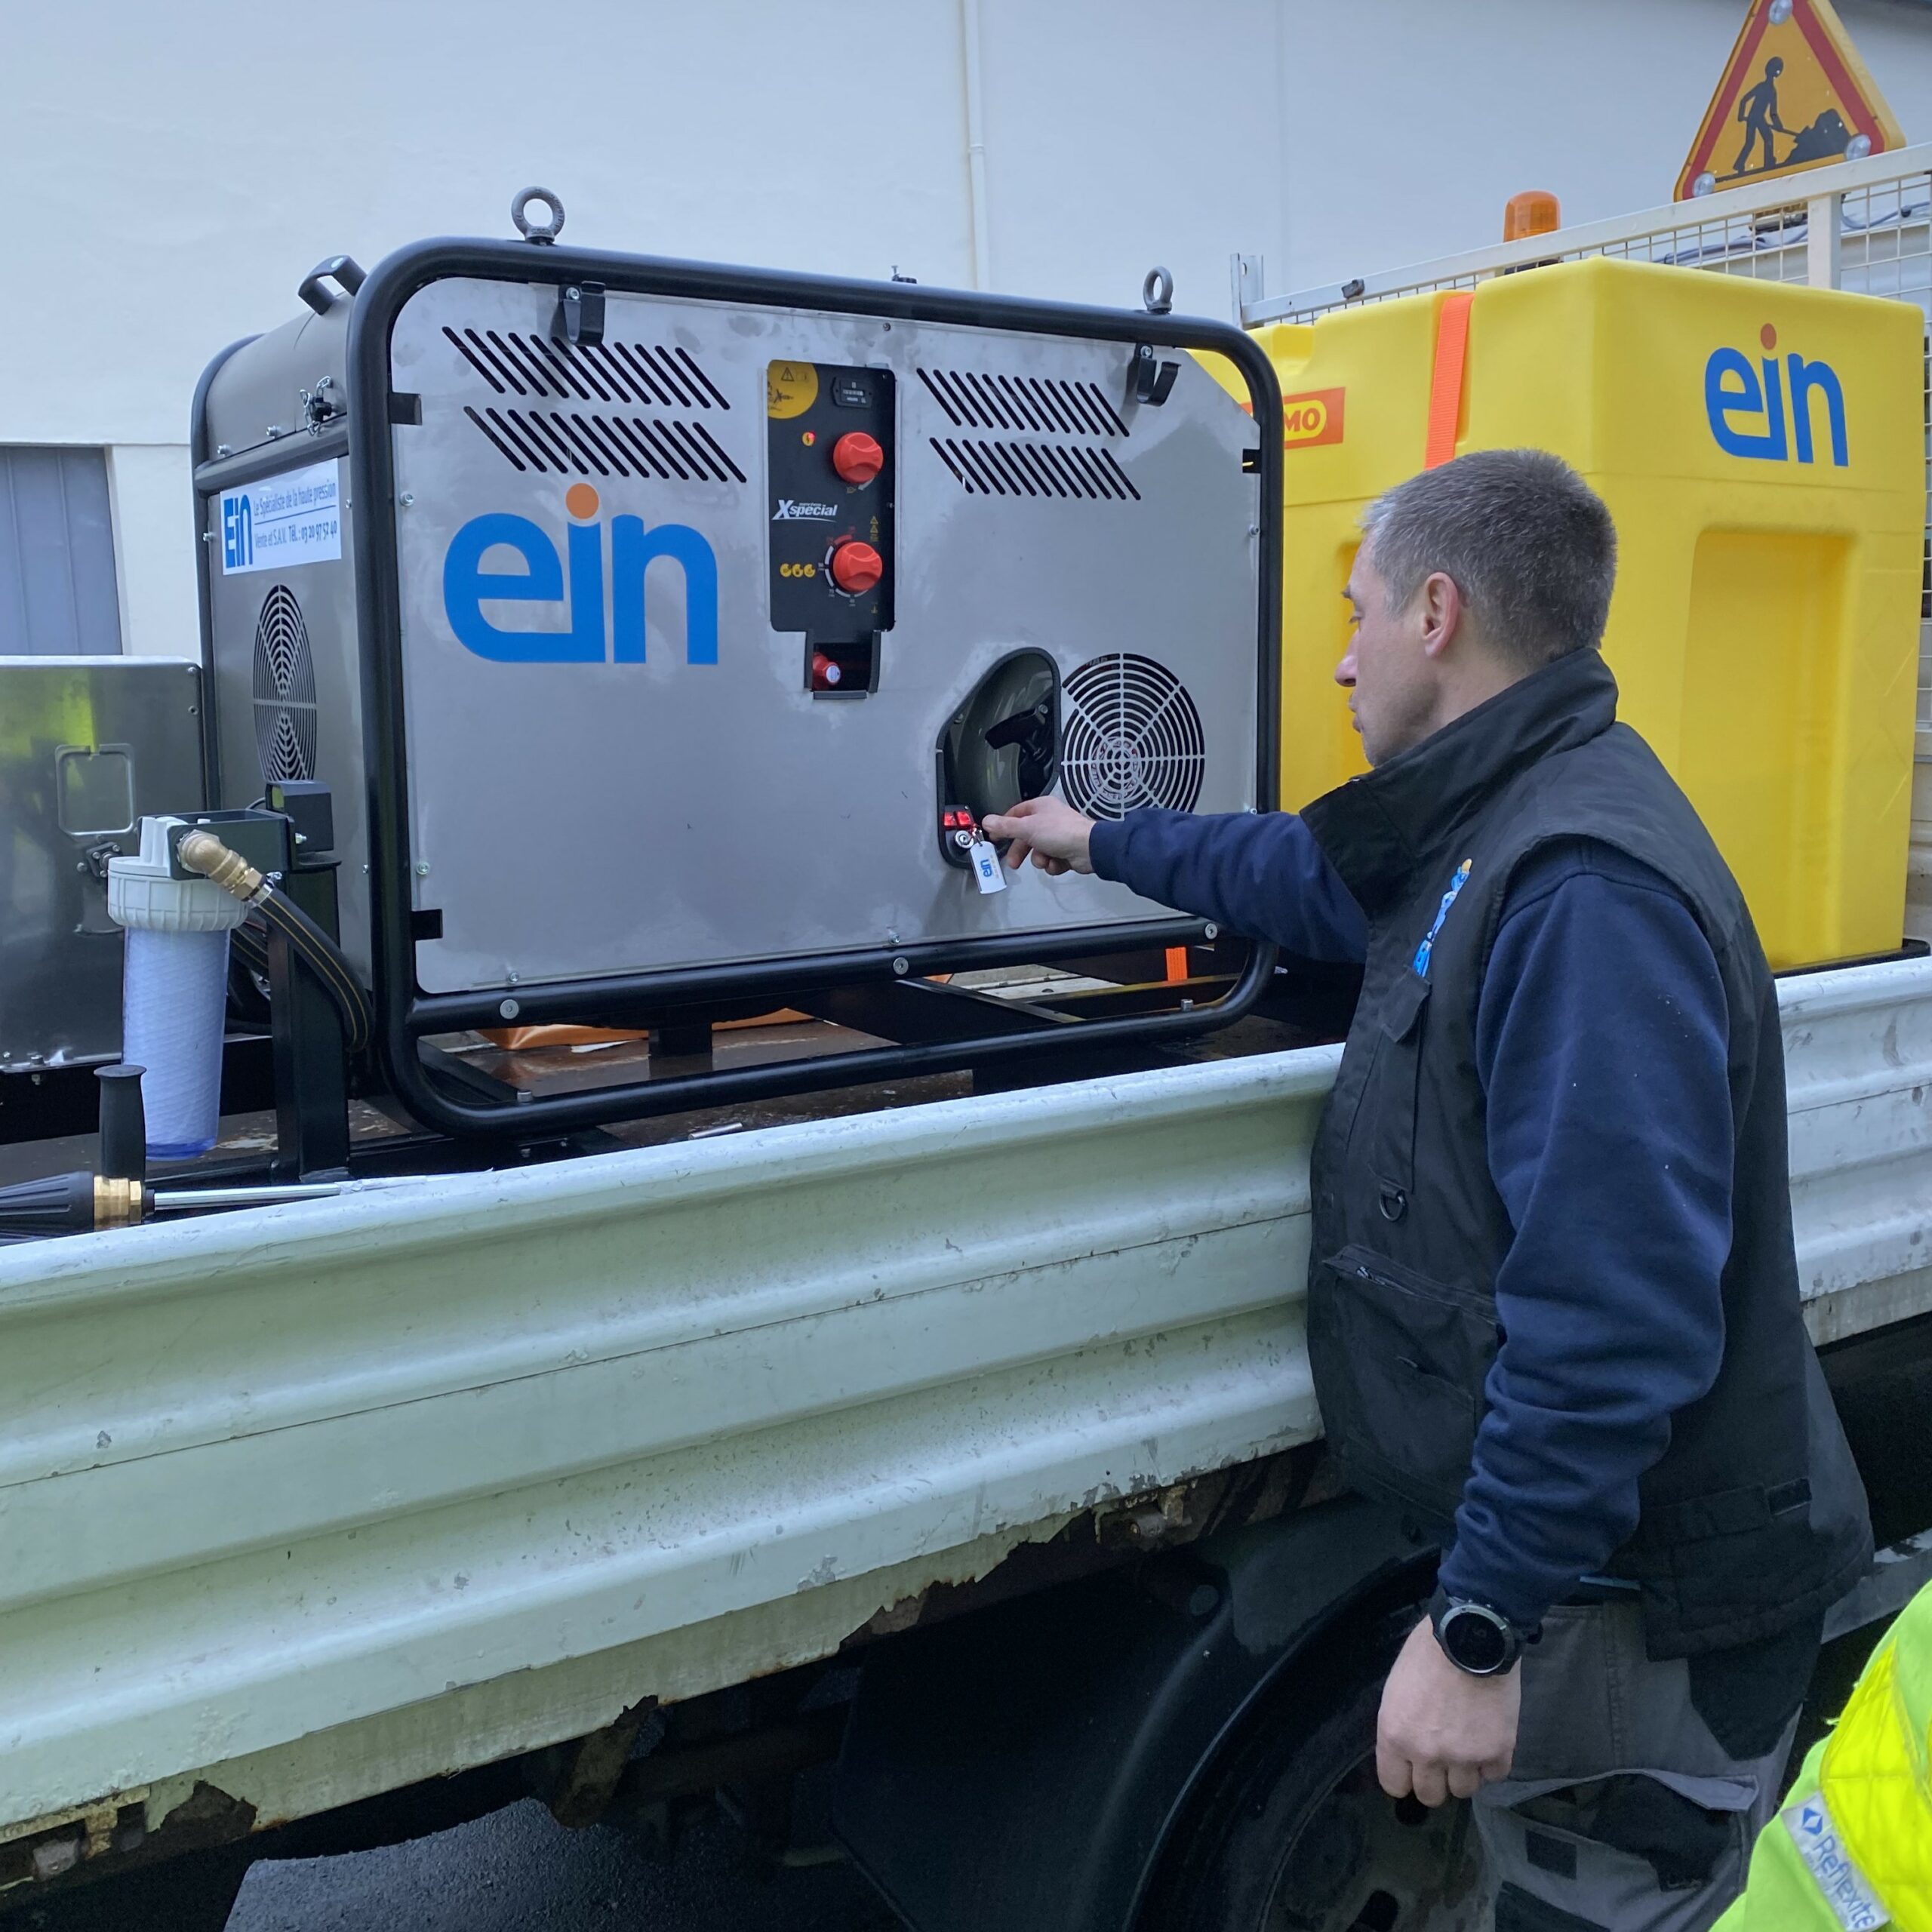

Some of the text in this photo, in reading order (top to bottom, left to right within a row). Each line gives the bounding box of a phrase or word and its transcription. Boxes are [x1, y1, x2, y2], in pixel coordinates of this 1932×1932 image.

[1283, 408, 1321, 432] MO
[1704, 323, 1849, 467] ein
[254, 500, 260, 516] Le
[286, 491, 293, 509] de
[293, 488, 298, 506] la
[298, 487, 312, 505] haute
[314, 479, 336, 506] pression
[255, 532, 267, 549] Vente
[268, 531, 273, 546] et
[301, 526, 308, 543] 03
[309, 525, 315, 538] 20
[315, 523, 322, 542] 97
[330, 520, 337, 539] 40
[442, 482, 718, 665] ein
[1812, 1835, 1875, 1929] Reflexite
